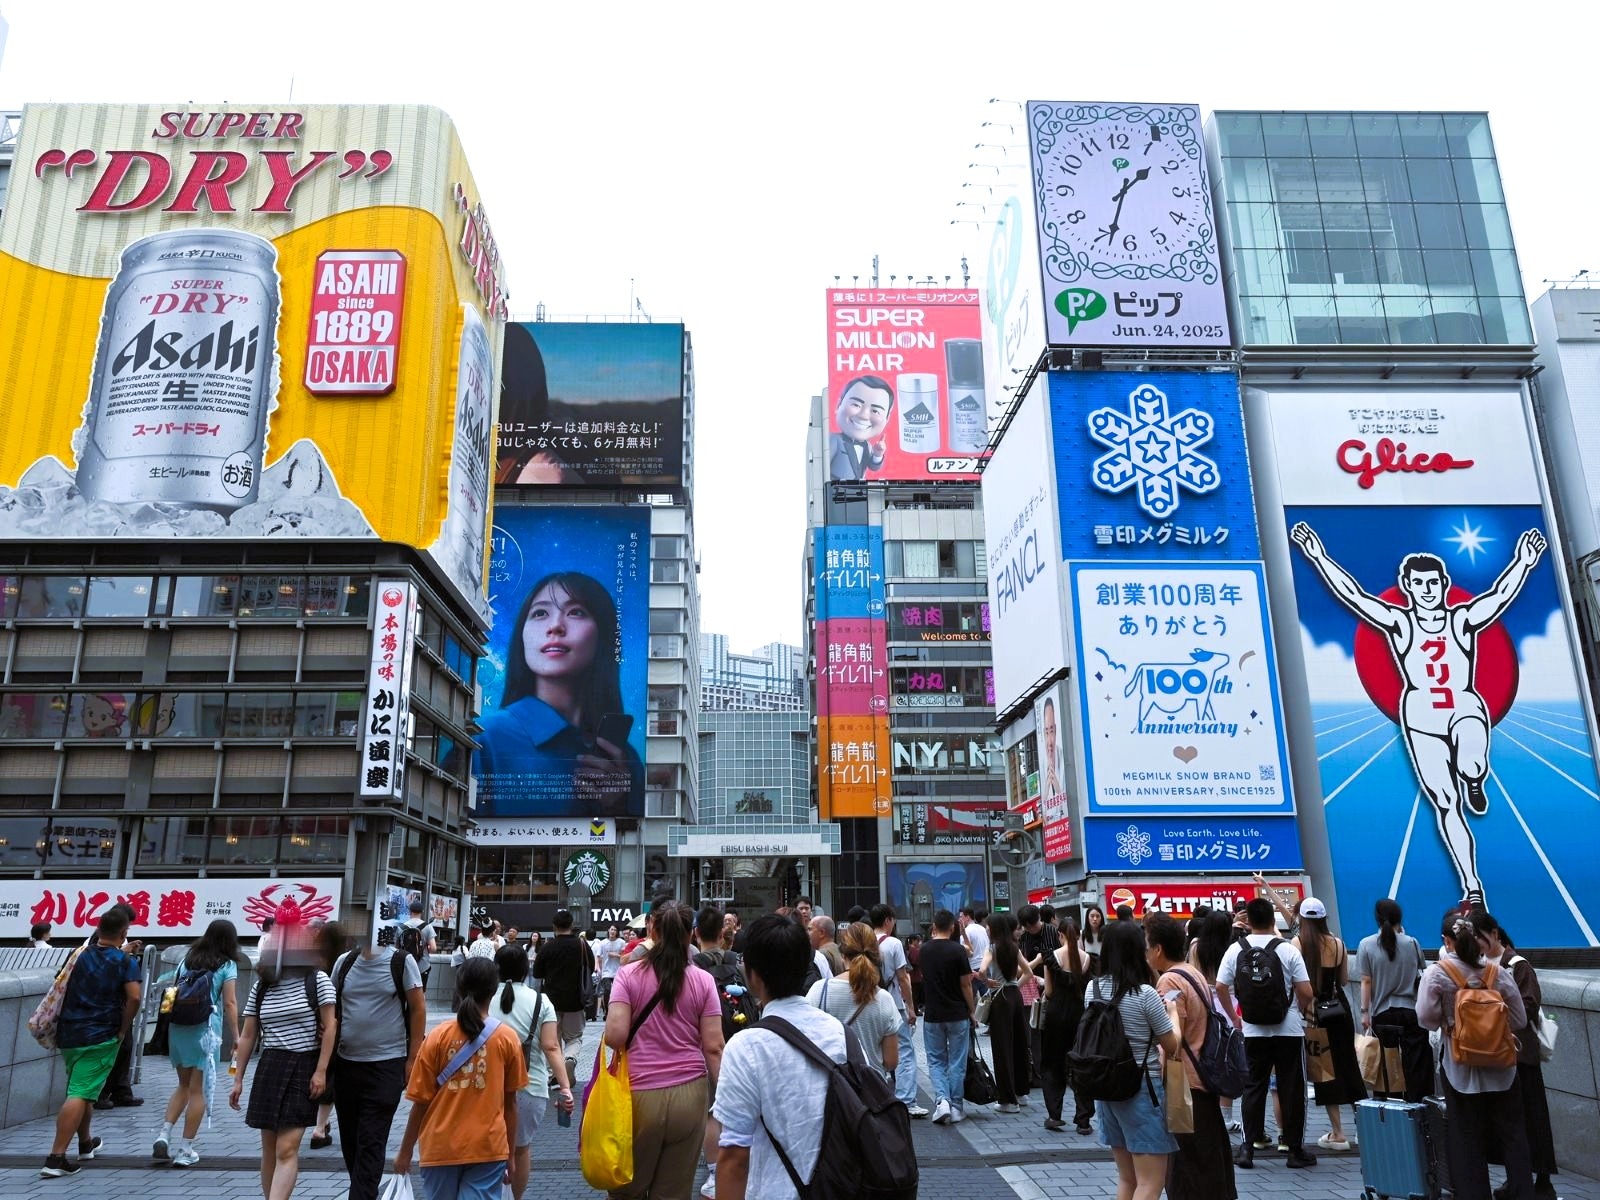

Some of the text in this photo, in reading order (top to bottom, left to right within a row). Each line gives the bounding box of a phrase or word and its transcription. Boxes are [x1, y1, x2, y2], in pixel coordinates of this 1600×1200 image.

[151, 111, 304, 141] SUPER
[1080, 137, 1103, 156] 11
[1107, 133, 1130, 150] 12
[1143, 142, 1154, 156] 1
[1059, 154, 1083, 176] 10
[1160, 160, 1179, 175] 2
[1056, 184, 1075, 197] 9
[1172, 186, 1191, 198] 3
[1066, 210, 1086, 224] 8
[1169, 210, 1187, 226] 4
[1093, 227, 1112, 243] 7
[1122, 234, 1137, 251] 6
[1150, 227, 1167, 245] 5
[159, 249, 242, 260] KARA 辛口 KUCHI
[171, 280, 225, 290] SUPER
[317, 263, 398, 296] ASAHI
[337, 294, 374, 310] since
[1113, 291, 1184, 318] ピップ
[835, 308, 925, 327] SUPER
[313, 311, 394, 344] 1889
[1112, 324, 1224, 338] Jun. 24, 2025
[111, 319, 260, 376] Asahi
[836, 331, 936, 349] MILLION
[308, 350, 389, 385] OSAKA
[836, 354, 904, 372] HAIR
[162, 380, 199, 402] 生
[132, 422, 221, 437] スーパードライ
[1336, 437, 1475, 490] Glico
[223, 464, 253, 488] お酒
[1093, 523, 1230, 545] 雪印メグミルク
[826, 549, 871, 568] 龍角散
[996, 528, 1046, 620] FANCL
[1096, 582, 1243, 606] 創業100周年
[901, 606, 944, 627] 焼肉
[1119, 614, 1227, 636] ありがとう
[921, 632, 967, 641] Welcome
[377, 612, 399, 682] 本場の味
[828, 643, 872, 663] 龍角散
[909, 672, 944, 690] 力丸
[1146, 668, 1233, 695] 100th
[1420, 636, 1455, 709] グリコ
[1130, 719, 1238, 738] Anniversary
[831, 741, 877, 762] 龍角散
[894, 741, 944, 768] NY
[1123, 771, 1251, 781] MEGMILK SNOW BRAND
[1103, 787, 1132, 796] 100th
[902, 808, 910, 841] 焼きそば
[916, 803, 926, 843] お好み焼き
[1163, 829, 1263, 837] Love Earth. Love Life.
[1159, 841, 1271, 861] 雪印メグミルク
[205, 908, 232, 916] 年中無休
[470, 906, 487, 915] KS
